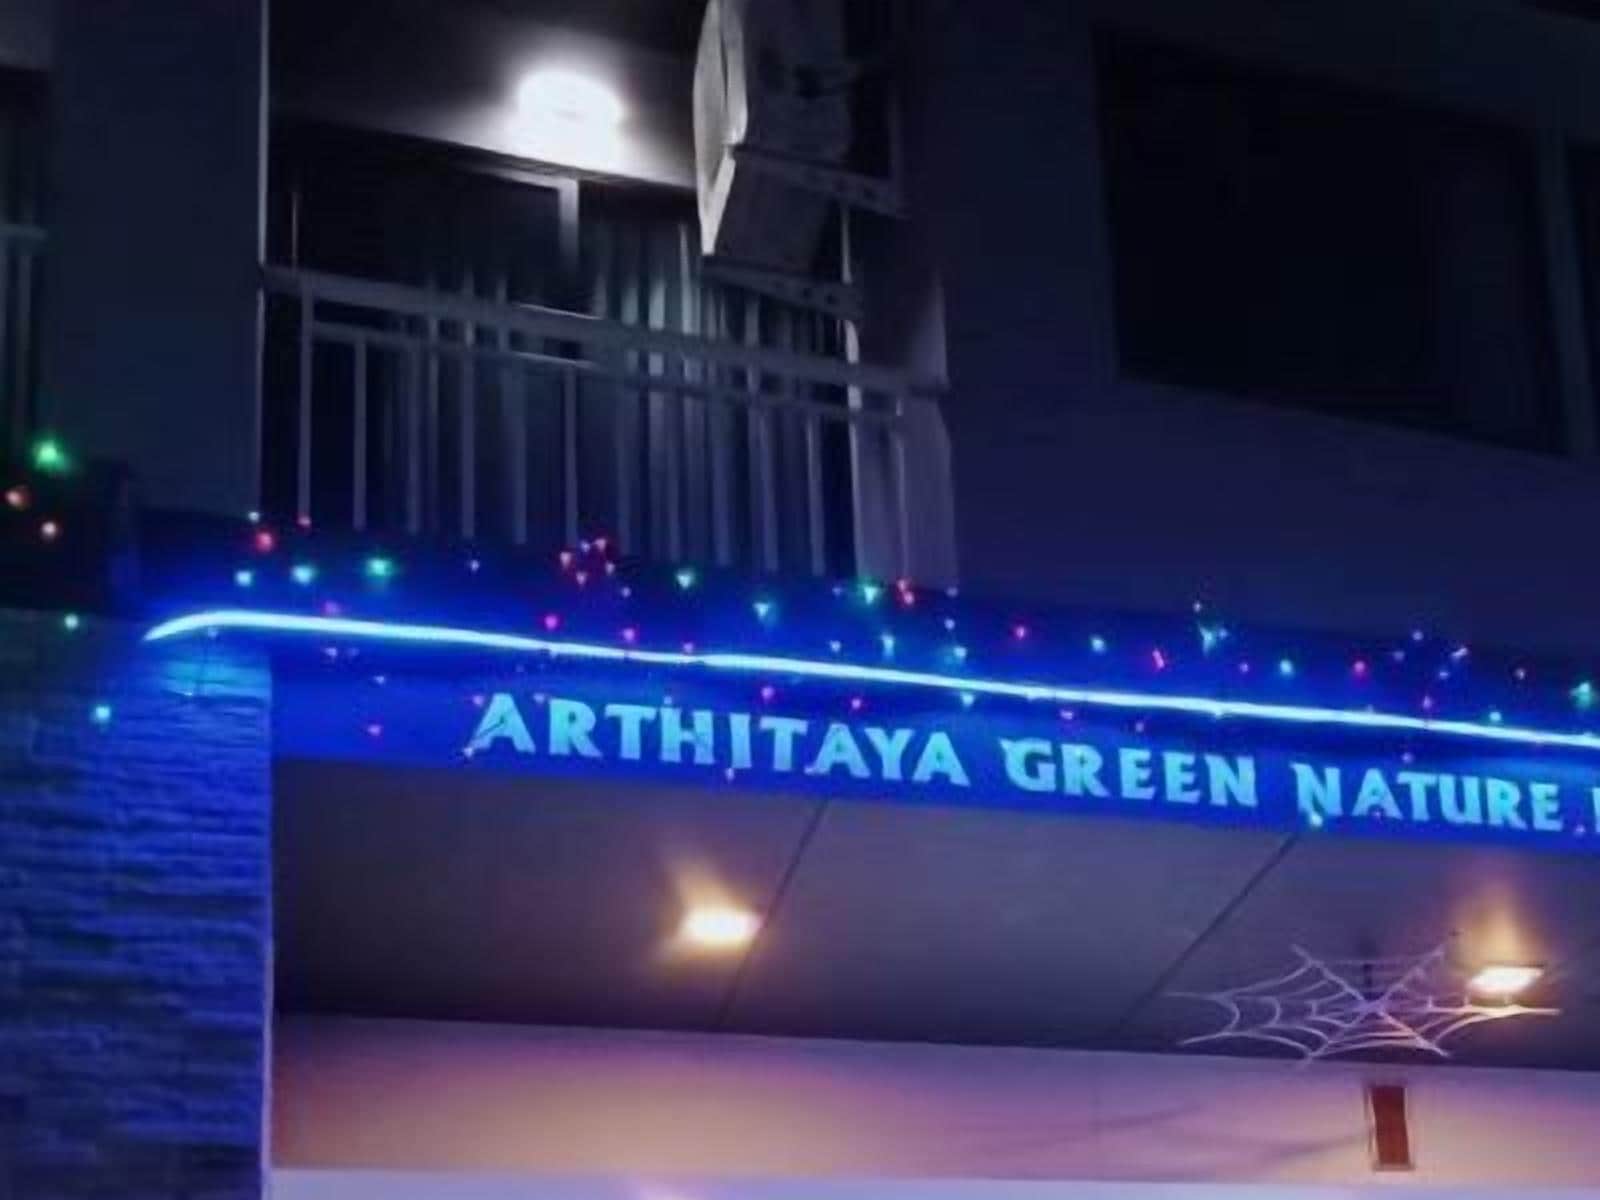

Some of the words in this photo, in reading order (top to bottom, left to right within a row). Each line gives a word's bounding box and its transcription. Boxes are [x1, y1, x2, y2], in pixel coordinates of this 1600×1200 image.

[469, 692, 971, 786] ARTHITAYA
[1000, 738, 1257, 806] GREEN
[1292, 762, 1562, 832] NATURE
